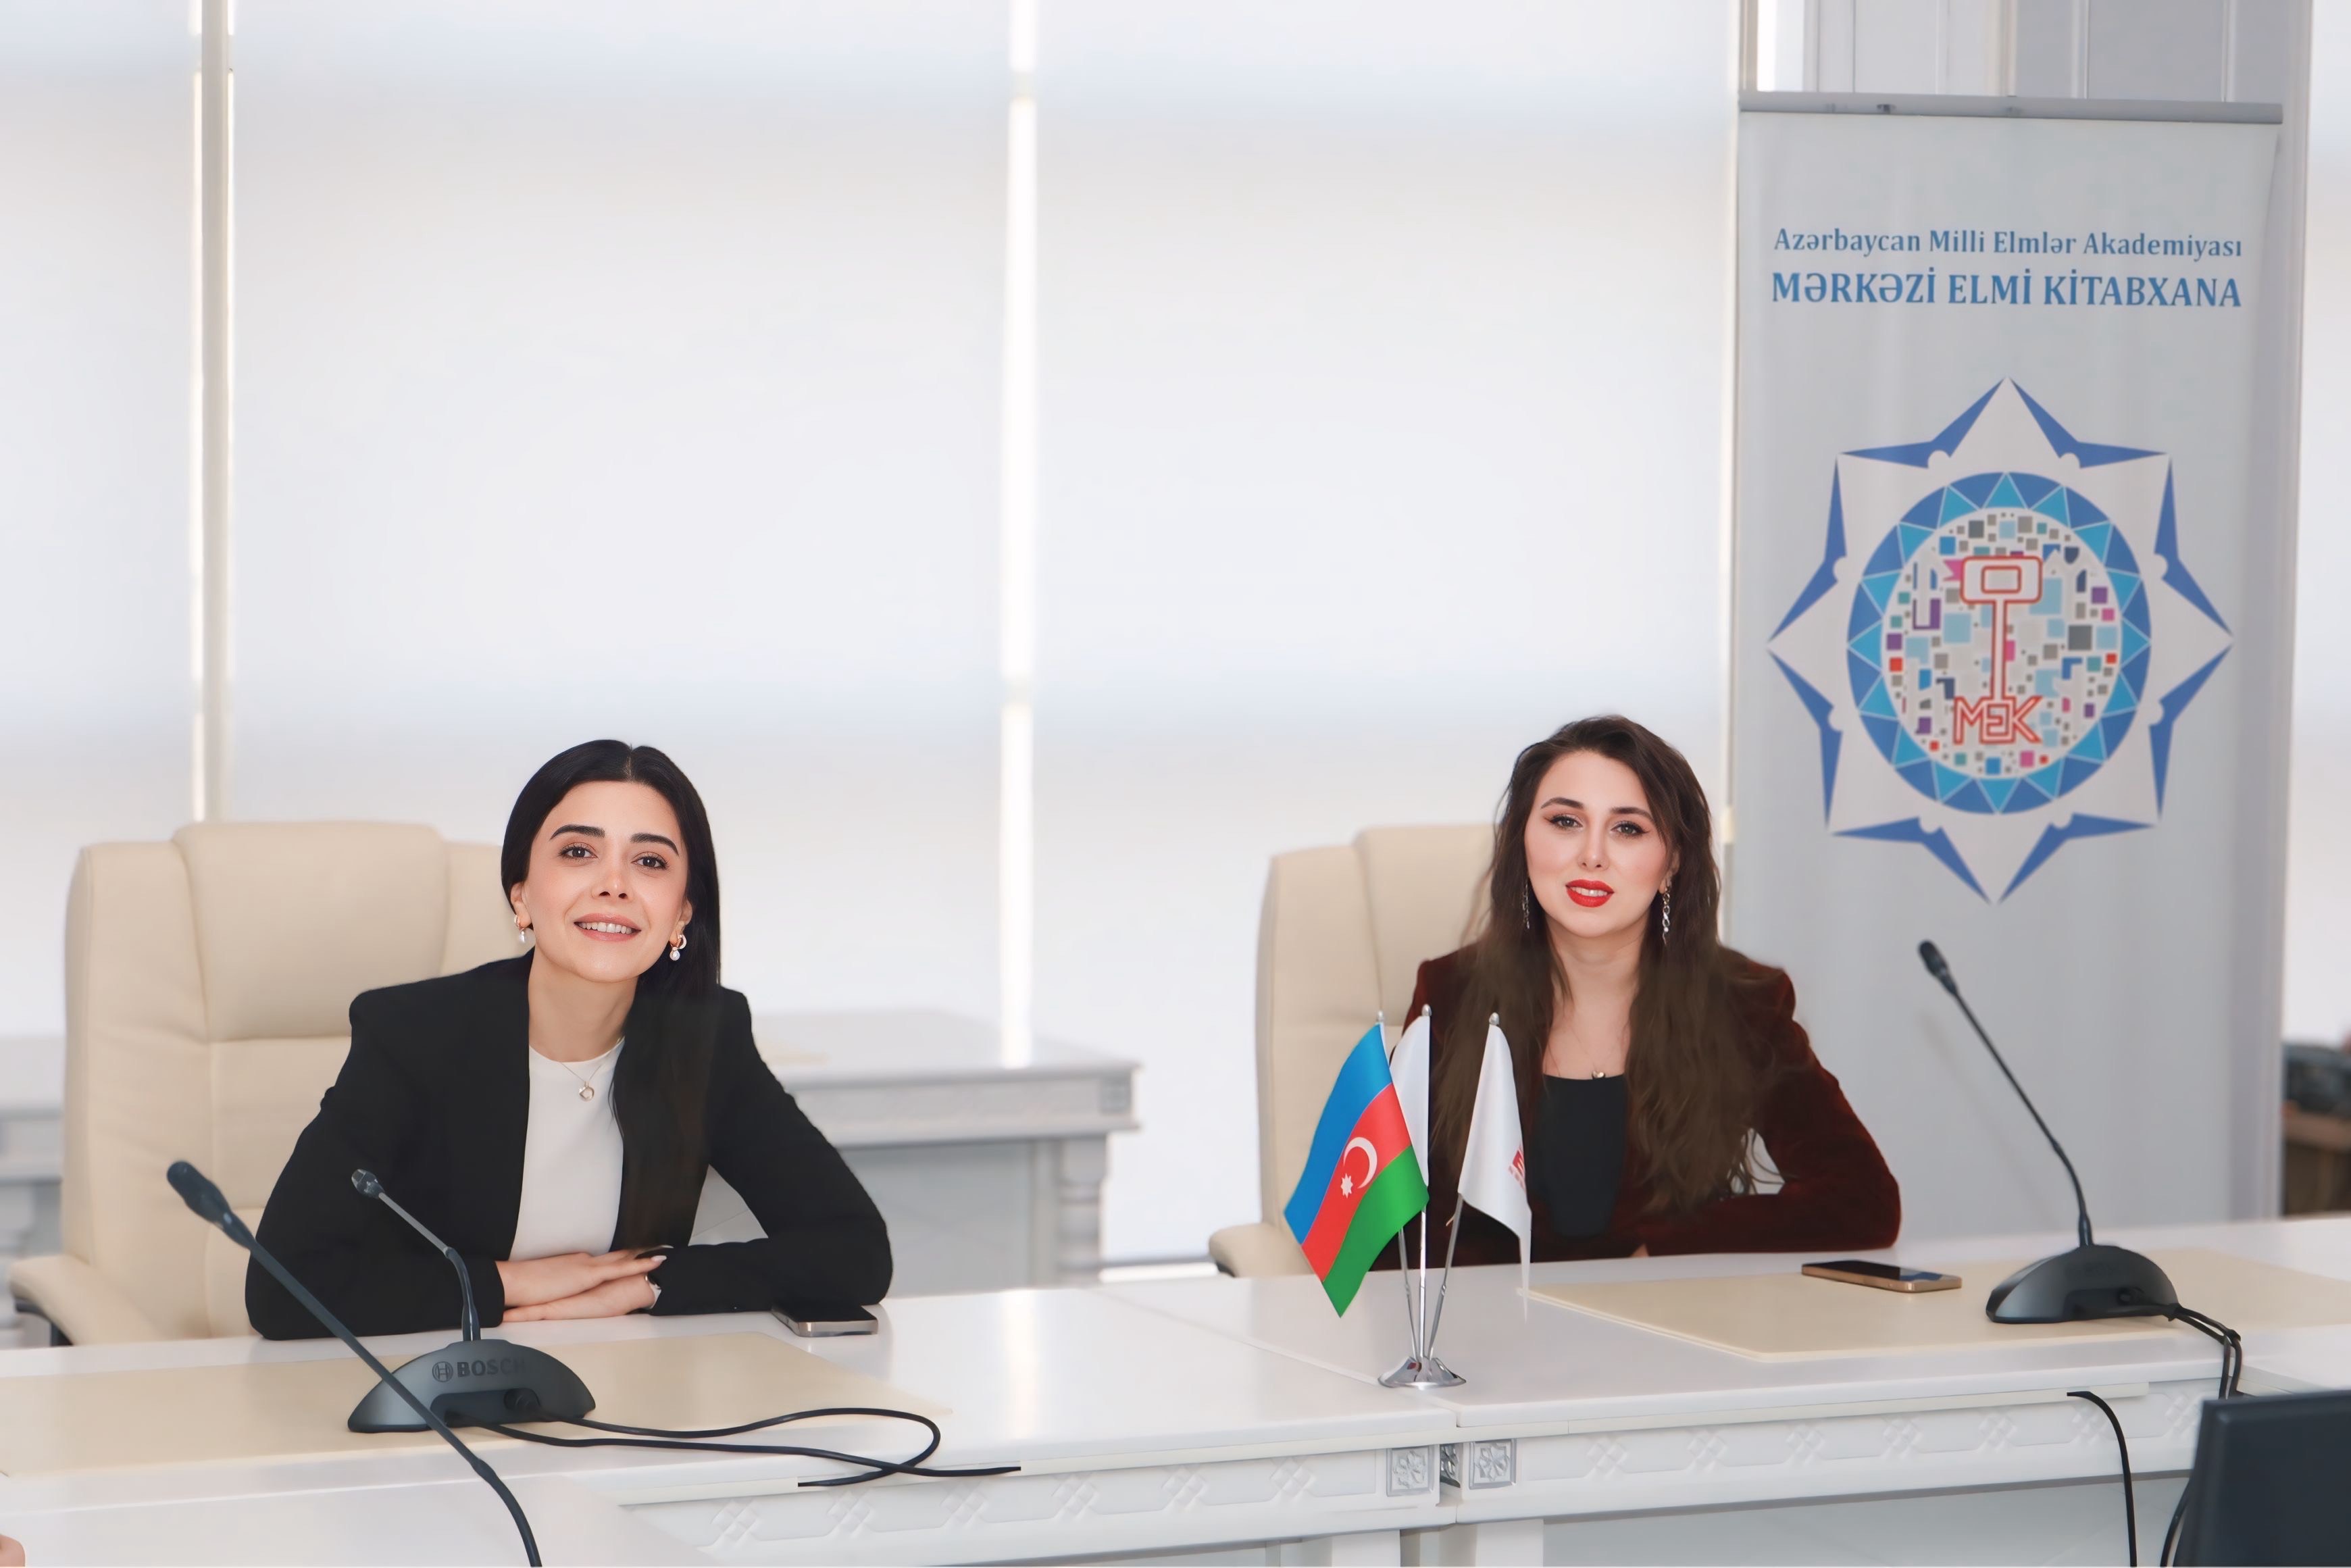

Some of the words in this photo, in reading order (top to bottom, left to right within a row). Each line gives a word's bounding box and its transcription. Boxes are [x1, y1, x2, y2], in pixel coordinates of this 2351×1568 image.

[1774, 228, 1920, 257] Azərbaycan
[1930, 230, 1984, 252] Milli
[1994, 231, 2076, 253] Elmlər
[2083, 232, 2242, 261] Akademiyası
[1772, 267, 1936, 303] MƏRKƏZİ
[1948, 268, 2031, 305] ELMİ
[2044, 270, 2242, 306] KİTABXANA
[457, 1359, 525, 1377] BOSCH
